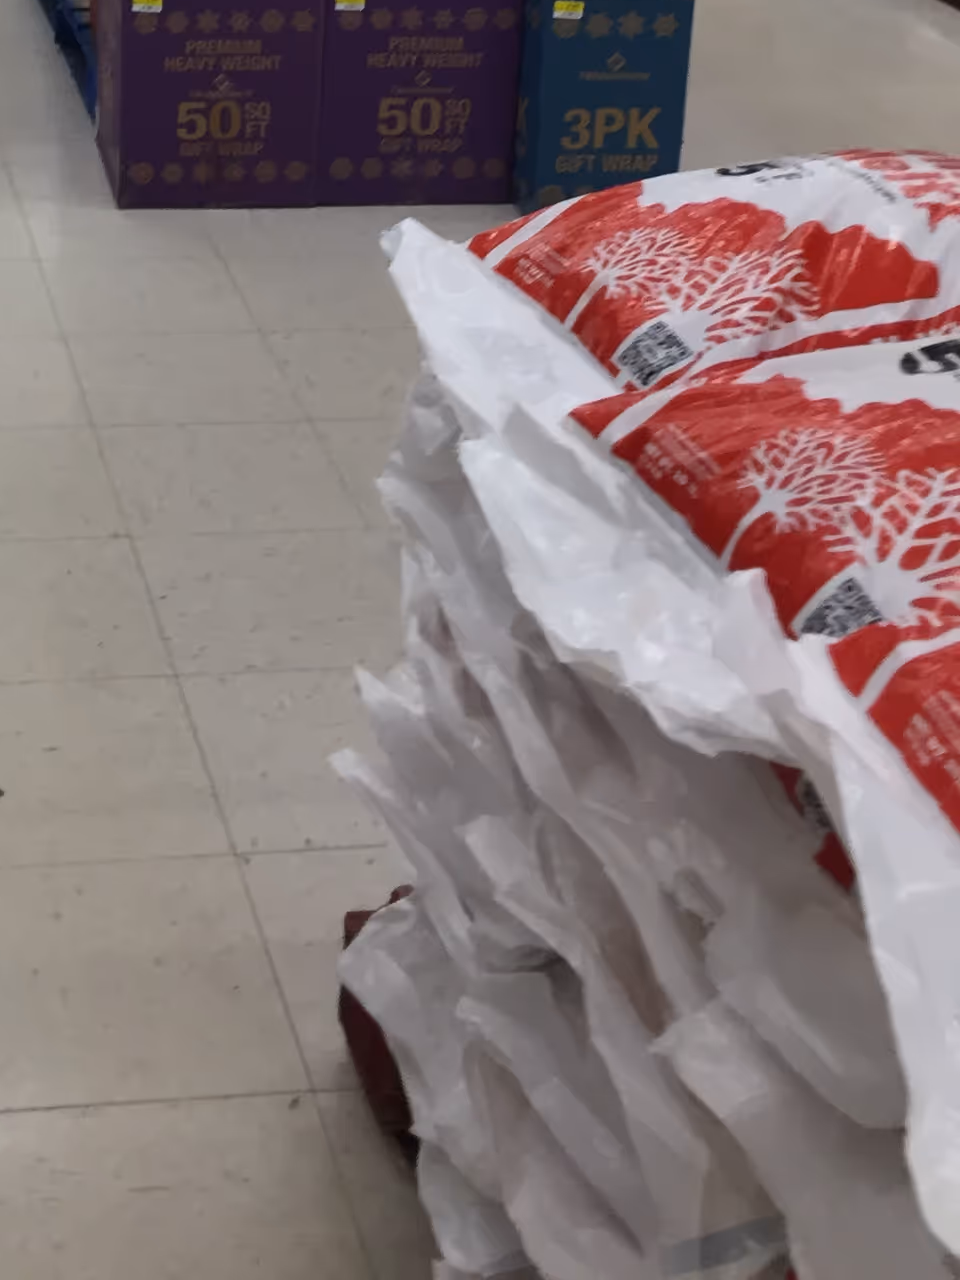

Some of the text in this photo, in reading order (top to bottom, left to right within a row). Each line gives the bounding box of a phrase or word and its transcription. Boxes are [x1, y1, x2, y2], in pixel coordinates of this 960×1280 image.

[185, 40, 262, 54] PREMIUM
[389, 36, 465, 51] PREMIUM
[164, 55, 282, 71] HEAVY WEIGHT
[366, 52, 484, 68] HEAVY WEIGHT
[176, 100, 241, 140] 50
[376, 96, 442, 136] 50
[245, 120, 269, 138] FT
[445, 118, 469, 135] FT
[560, 107, 662, 151] 3PK
[555, 153, 658, 173] GIFT WRAP
